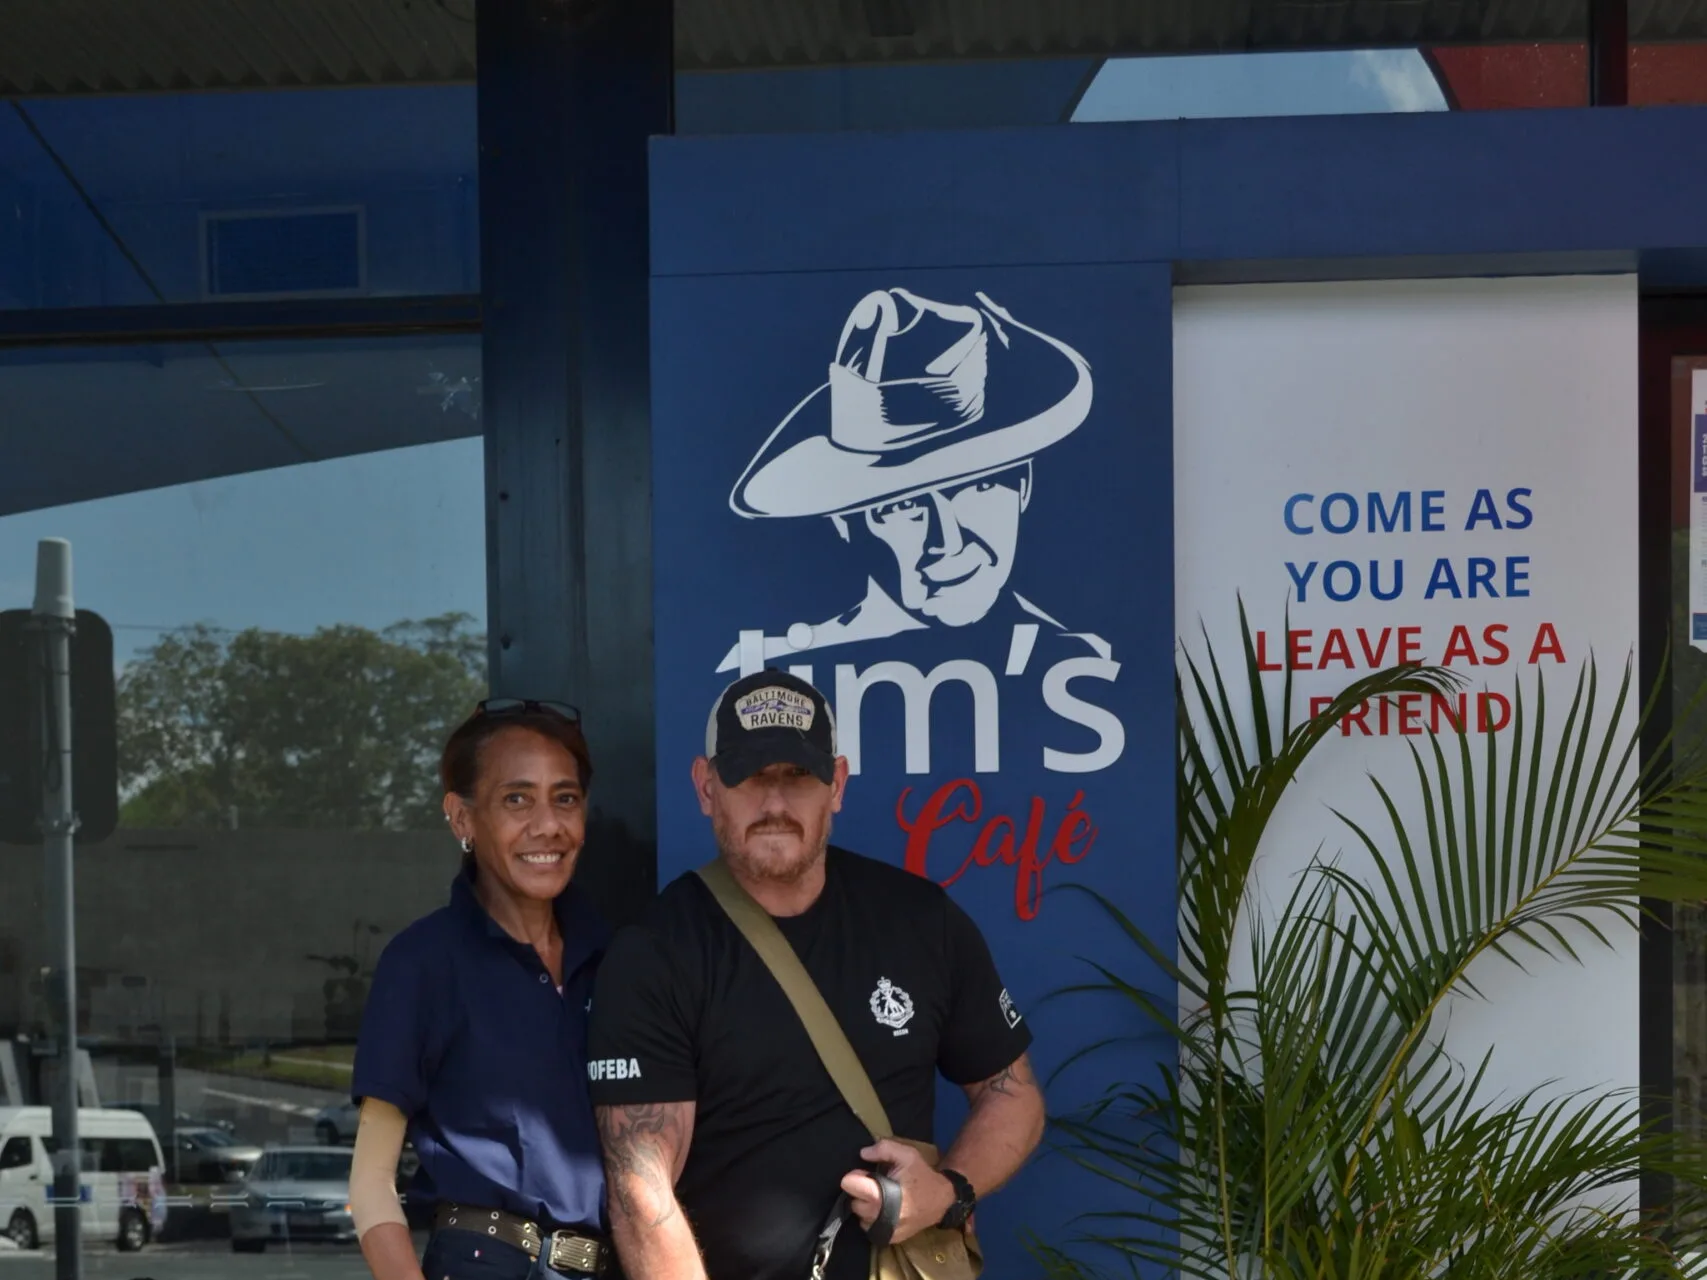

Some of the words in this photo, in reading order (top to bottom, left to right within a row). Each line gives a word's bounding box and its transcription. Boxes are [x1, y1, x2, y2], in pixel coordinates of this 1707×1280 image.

[1283, 490, 1446, 535] COME
[1464, 487, 1533, 531] AS
[1284, 559, 1404, 603] YOU
[1424, 556, 1530, 600] ARE
[1256, 626, 1422, 671] LEAVE
[1441, 623, 1510, 667] AS
[1528, 622, 1567, 665] A
[739, 622, 1126, 775] m's
[745, 690, 805, 706] BALTIMORE
[750, 712, 804, 727] RAVENS
[1309, 692, 1512, 737] FRIEND
[895, 778, 1098, 922] Café
[587, 1057, 642, 1081] OFEBA
